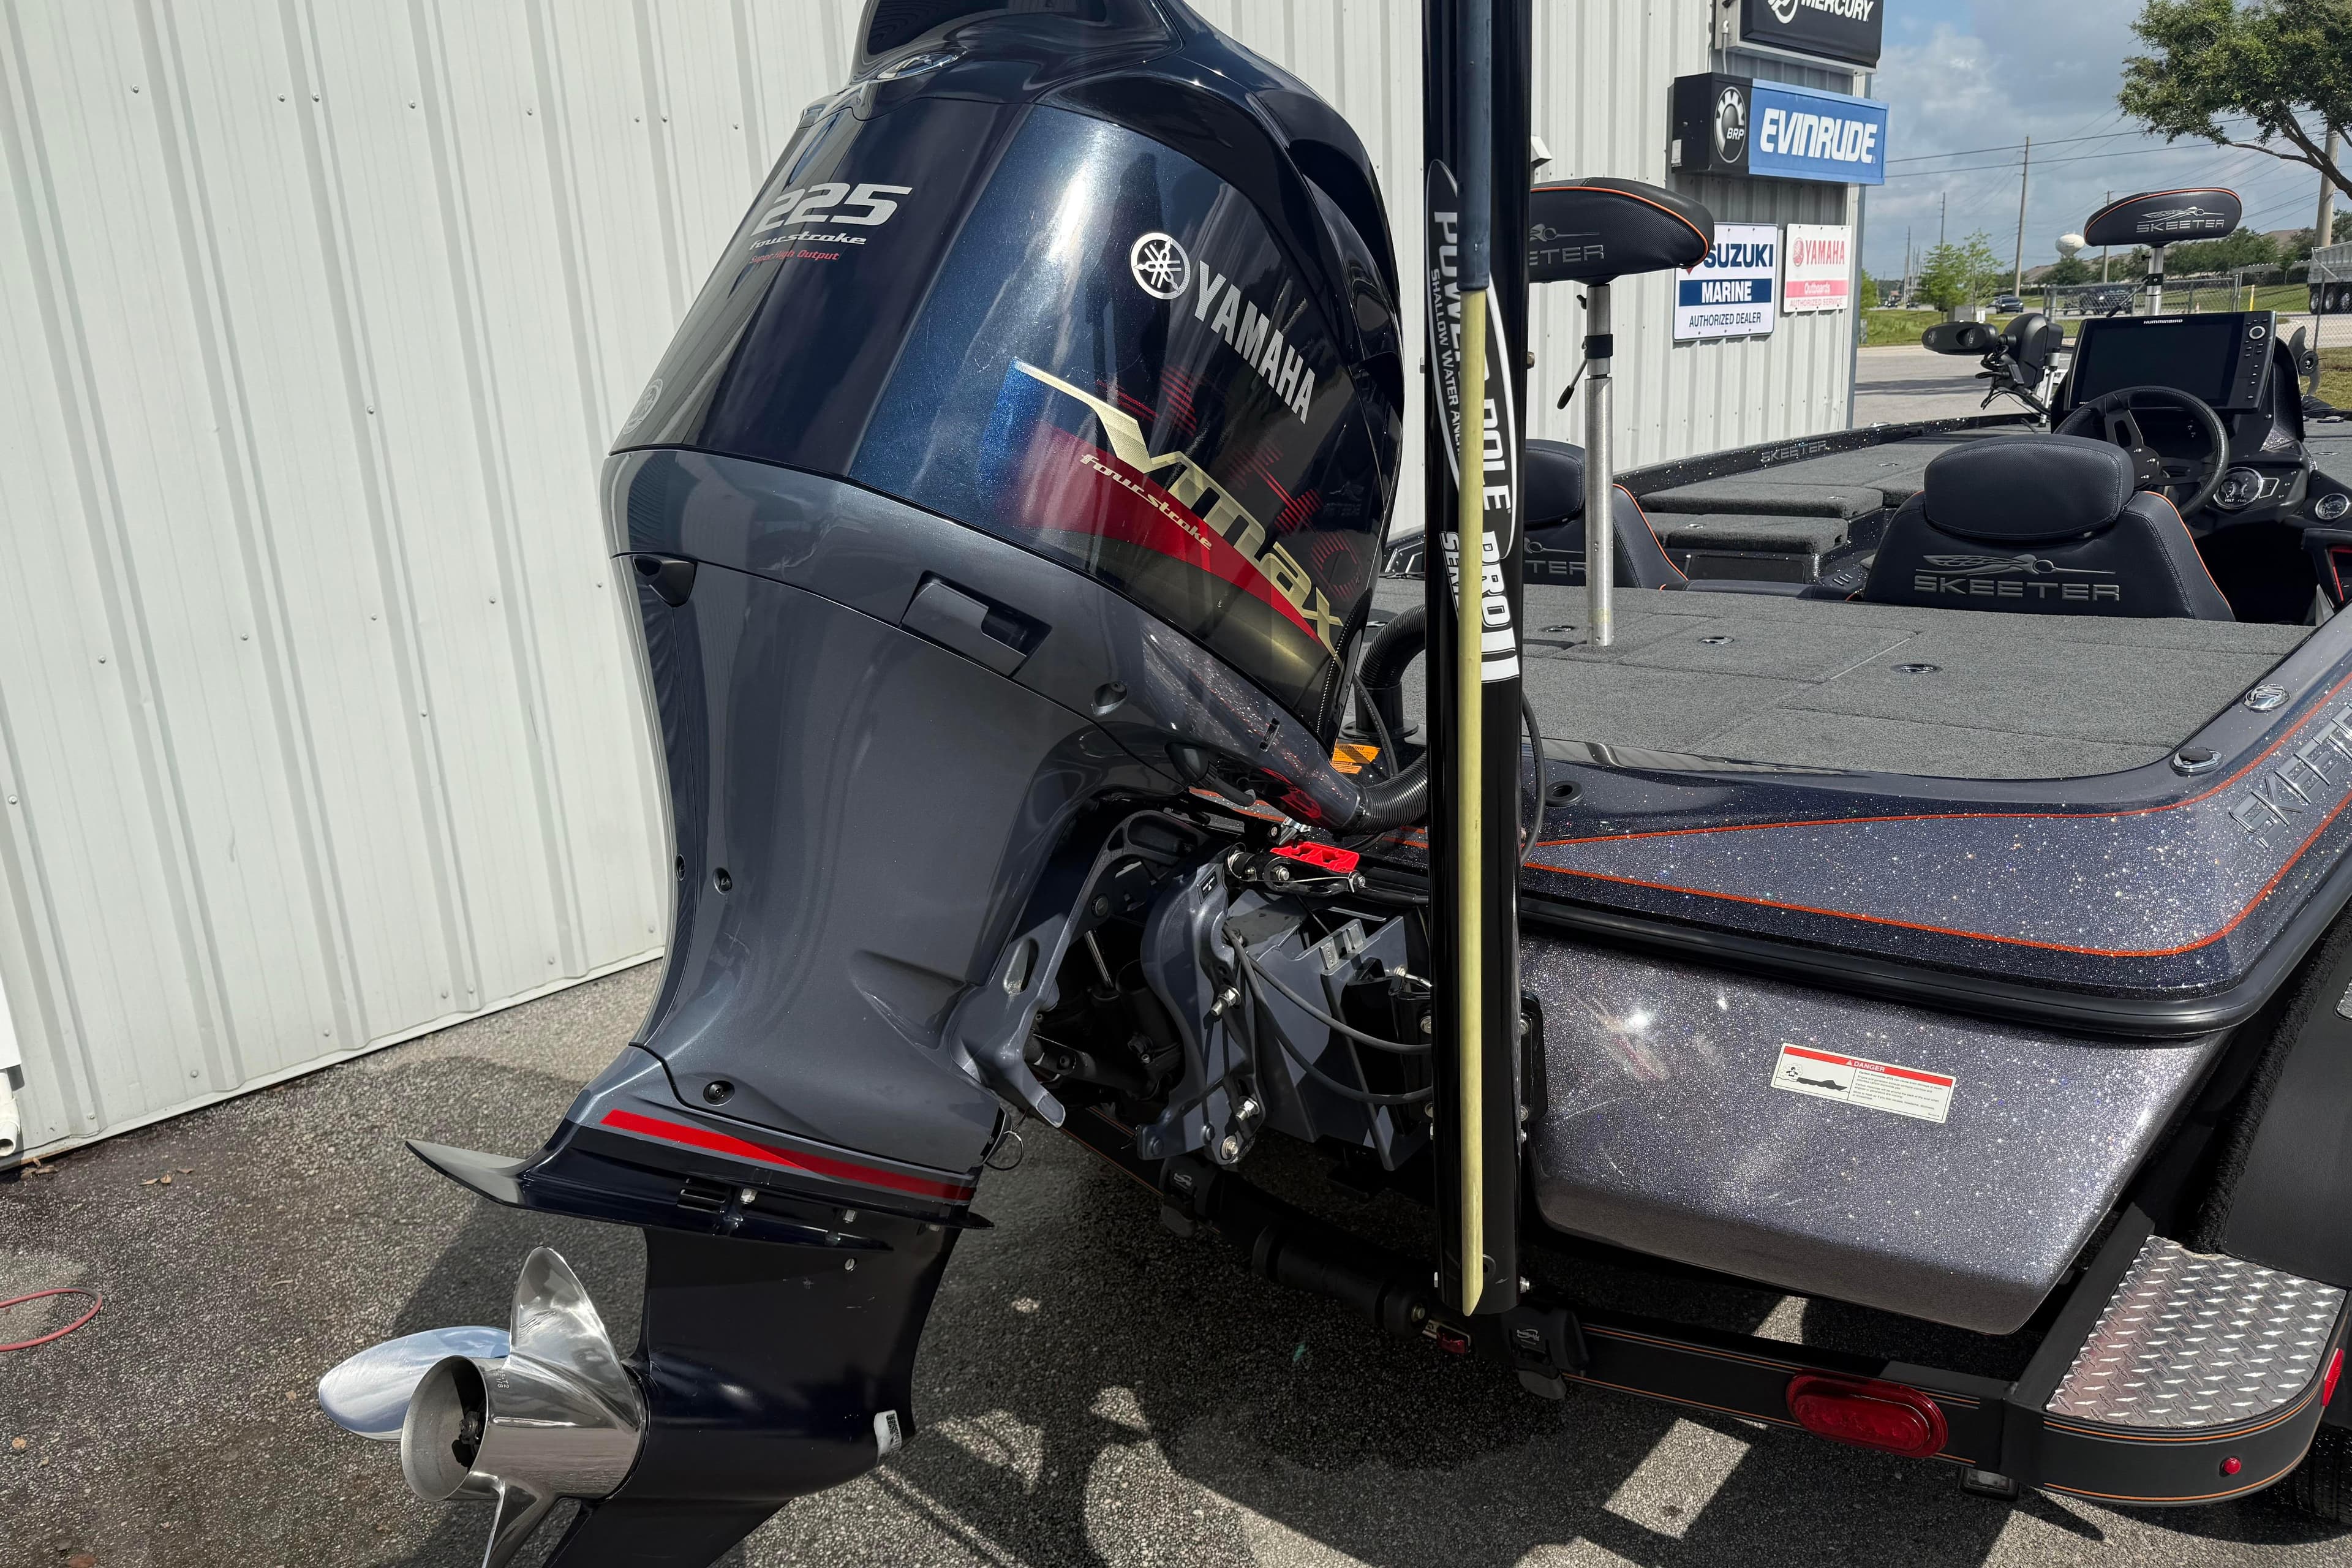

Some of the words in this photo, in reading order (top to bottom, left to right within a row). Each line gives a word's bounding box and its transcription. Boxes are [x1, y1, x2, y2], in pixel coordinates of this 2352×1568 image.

[1800, 0, 1874, 22] RCURY
[1726, 127, 1744, 140] BRP
[1760, 107, 1878, 164] EVINRUDE
[750, 183, 913, 236] 225
[2136, 219, 2225, 233] SKEETER
[796, 249, 840, 261] Output
[1703, 243, 1774, 268] SUZUKI
[1804, 239, 1845, 265] YAMAHA
[1701, 280, 1752, 304] MARINE
[1804, 281, 1831, 295] Outboards
[1789, 298, 1822, 307] AUTHORIZED
[1822, 297, 1843, 306] SERVICE
[1689, 314, 1734, 328] AUTHORIZED
[1735, 311, 1762, 325] DEALER
[1198, 260, 1316, 425] YAMAHA
[1431, 268, 1449, 347] SHALLOW
[1441, 349, 1459, 406] WATER
[1762, 440, 1826, 464] SKEETER
[1914, 574, 2120, 602] SKEETER
[2229, 703, 2352, 849] SKEET
[1853, 1061, 1885, 1072] DANGER
